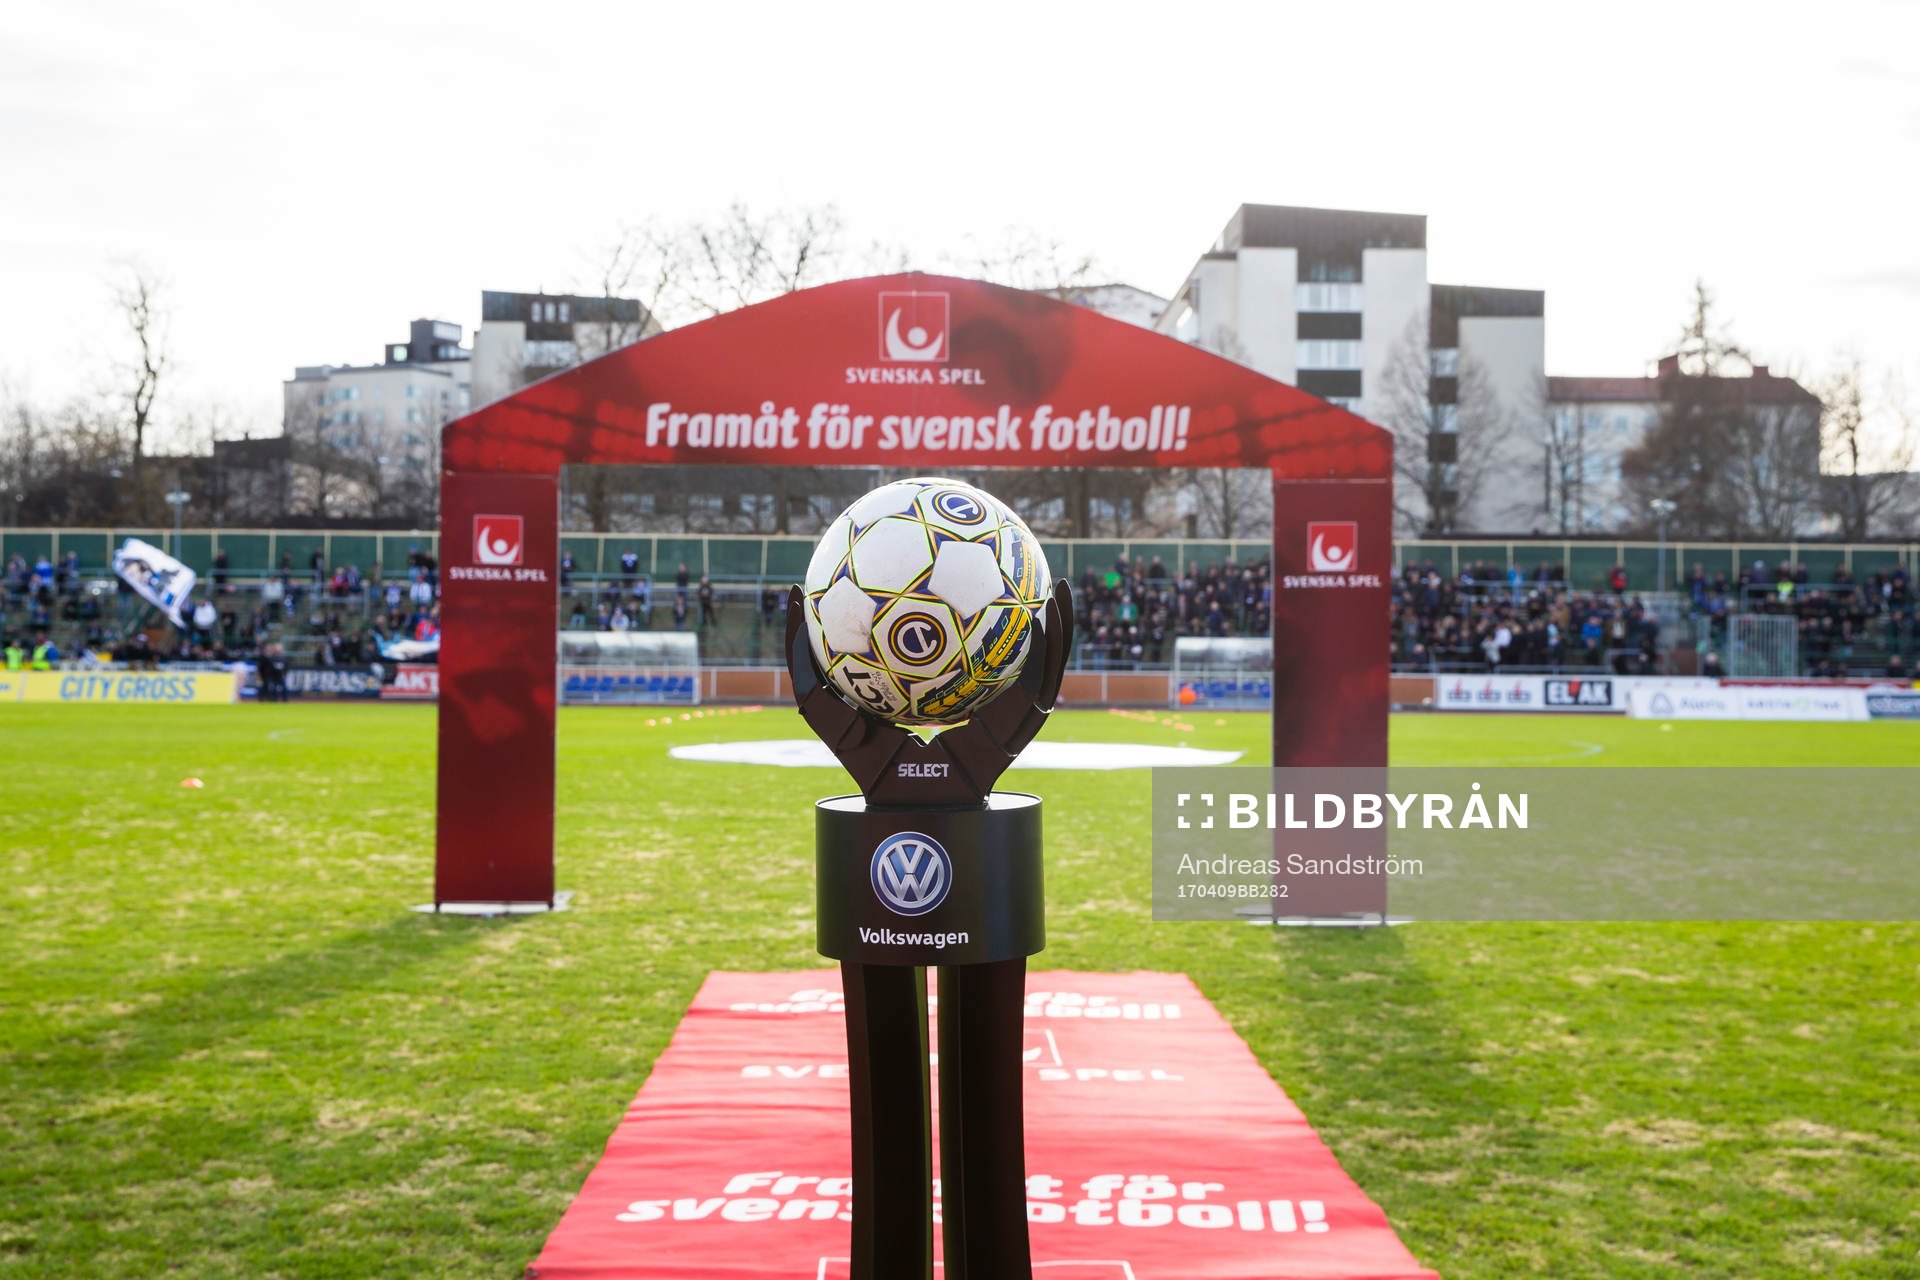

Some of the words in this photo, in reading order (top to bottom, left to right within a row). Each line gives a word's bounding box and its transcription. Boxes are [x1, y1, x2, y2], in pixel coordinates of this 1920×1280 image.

[845, 366, 934, 385] SVENSKA
[939, 368, 985, 386] SPEL
[645, 401, 800, 448] Framåt
[807, 404, 873, 450] för
[878, 408, 1023, 451] svensk
[1030, 406, 1192, 452] fotboll!
[449, 567, 512, 580] SVENSKA
[514, 569, 547, 582] SPEL
[1283, 575, 1346, 589] SVENSKA
[1348, 575, 1382, 589] SPEL
[60, 676, 115, 700] CITY
[117, 676, 196, 700] GROSS
[898, 763, 950, 778] SELECT
[859, 927, 969, 948] Volkswagen
[1081, 1174, 1225, 1200] för
[1026, 1199, 1330, 1233] otboll!
